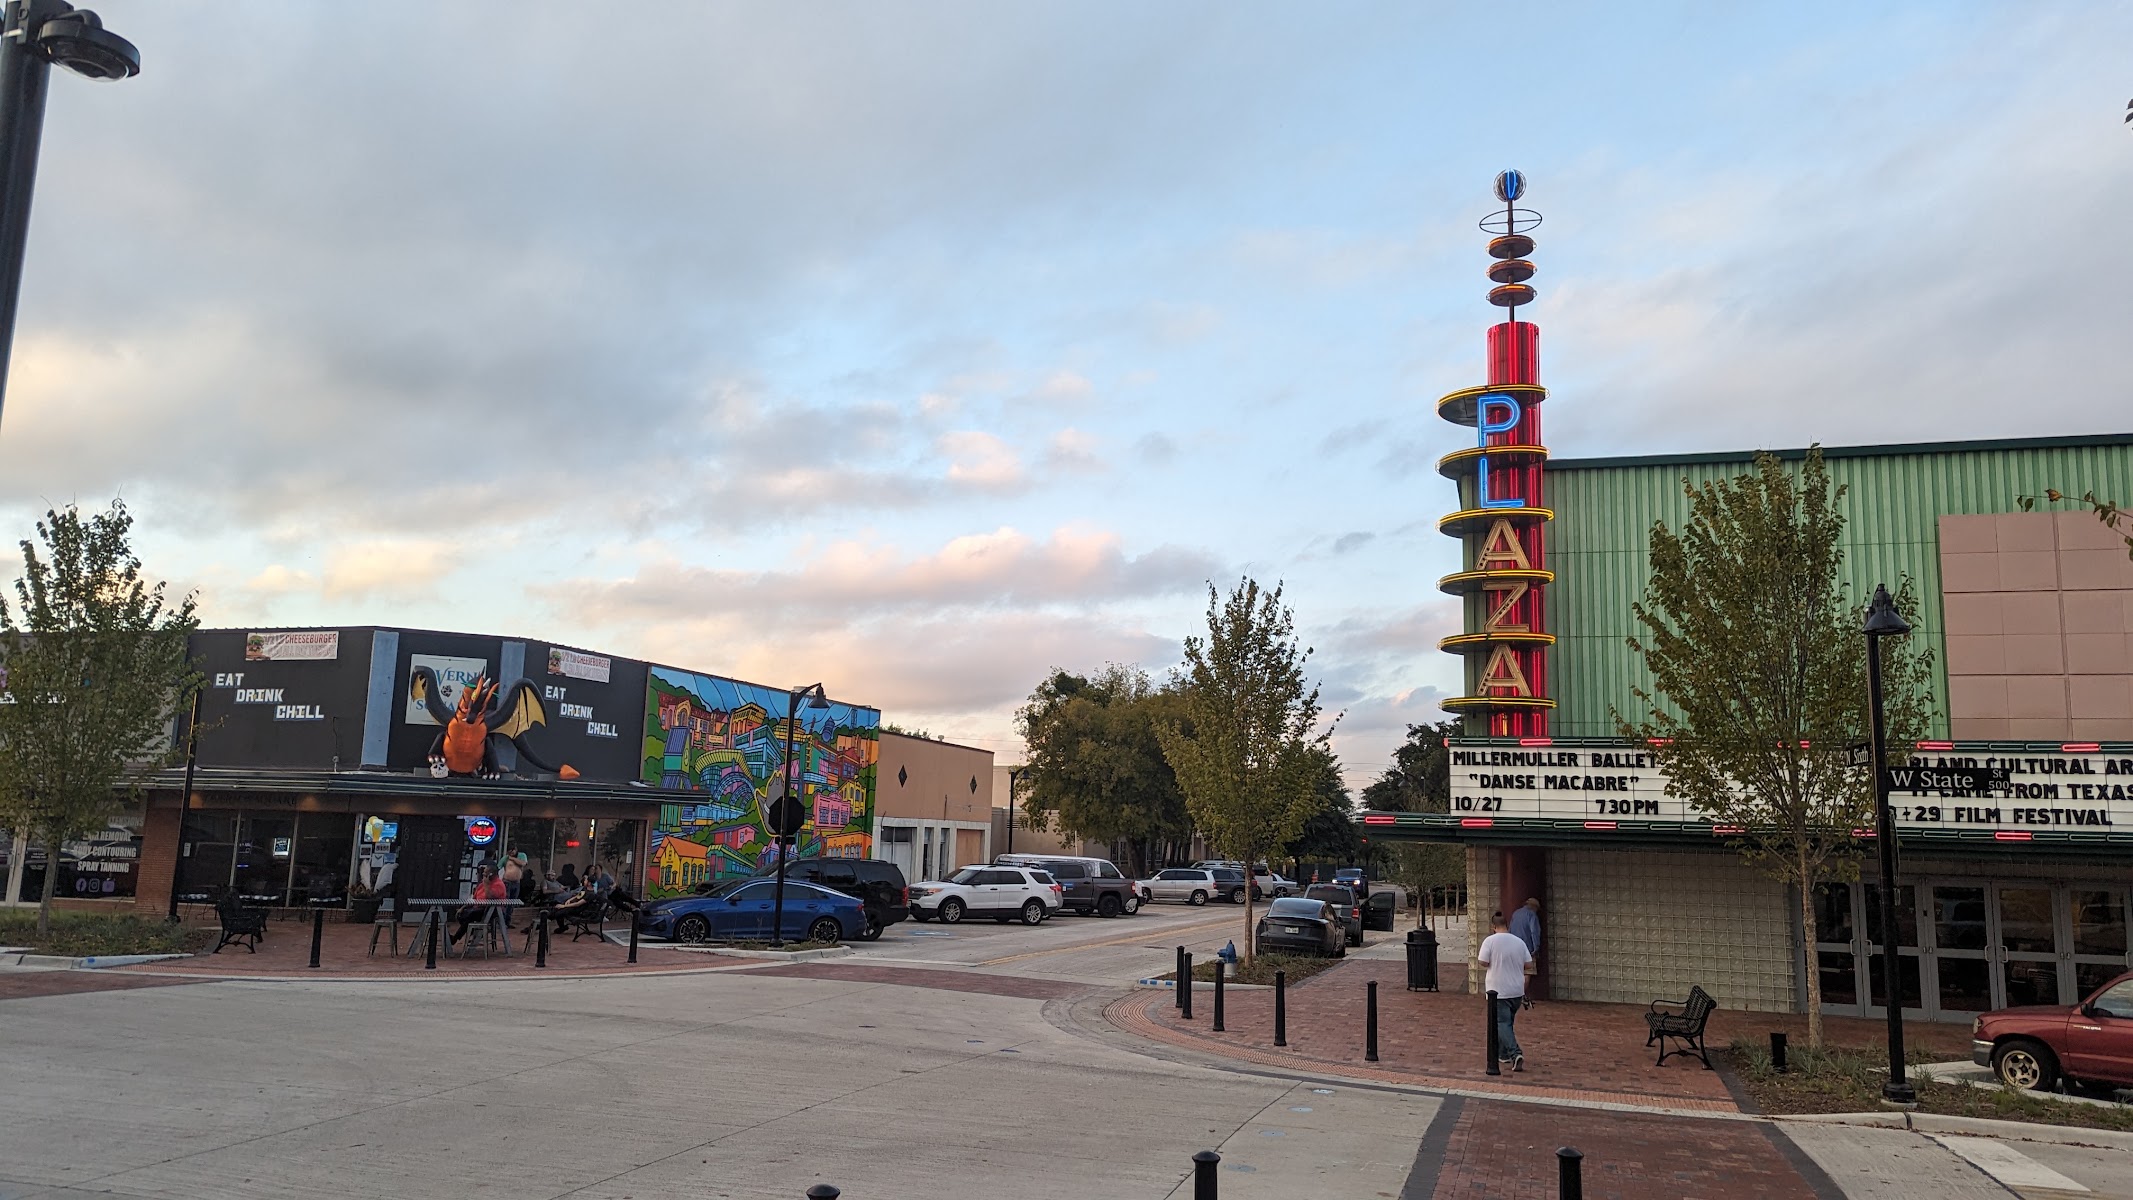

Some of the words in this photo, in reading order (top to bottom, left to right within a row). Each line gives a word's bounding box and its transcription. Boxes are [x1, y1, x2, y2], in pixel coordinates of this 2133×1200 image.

[1474, 393, 1531, 697] PLAZA
[285, 633, 337, 644] CHEESEBURGER
[215, 673, 245, 686] EAT
[236, 688, 285, 702] DRINK
[545, 685, 567, 700] EAT
[276, 704, 325, 719] CHILL
[560, 703, 594, 719] DRINK
[587, 721, 619, 737] CHILL
[1453, 751, 1579, 767] MILLERMULLER
[1592, 753, 1657, 768] BALLET
[1853, 746, 1869, 765] Sixth
[1986, 758, 2096, 775] CULTURAL
[1469, 773, 1536, 789] "DANSE
[1545, 775, 1640, 791] MACABRE"
[1890, 770, 1914, 787] W
[1920, 770, 1974, 788] State
[1992, 768, 2004, 779] St
[1988, 780, 2010, 790] 500
[2004, 783, 2059, 799] FROM
[1455, 796, 1502, 812] 10/27
[1955, 807, 2001, 824] FILM
[2013, 808, 2113, 825] FESTIVAL
[100, 831, 132, 842] REMOVAL
[92, 846, 137, 858] CONTOURING
[77, 861, 98, 872] SPRAY
[100, 862, 130, 873] TANNING
